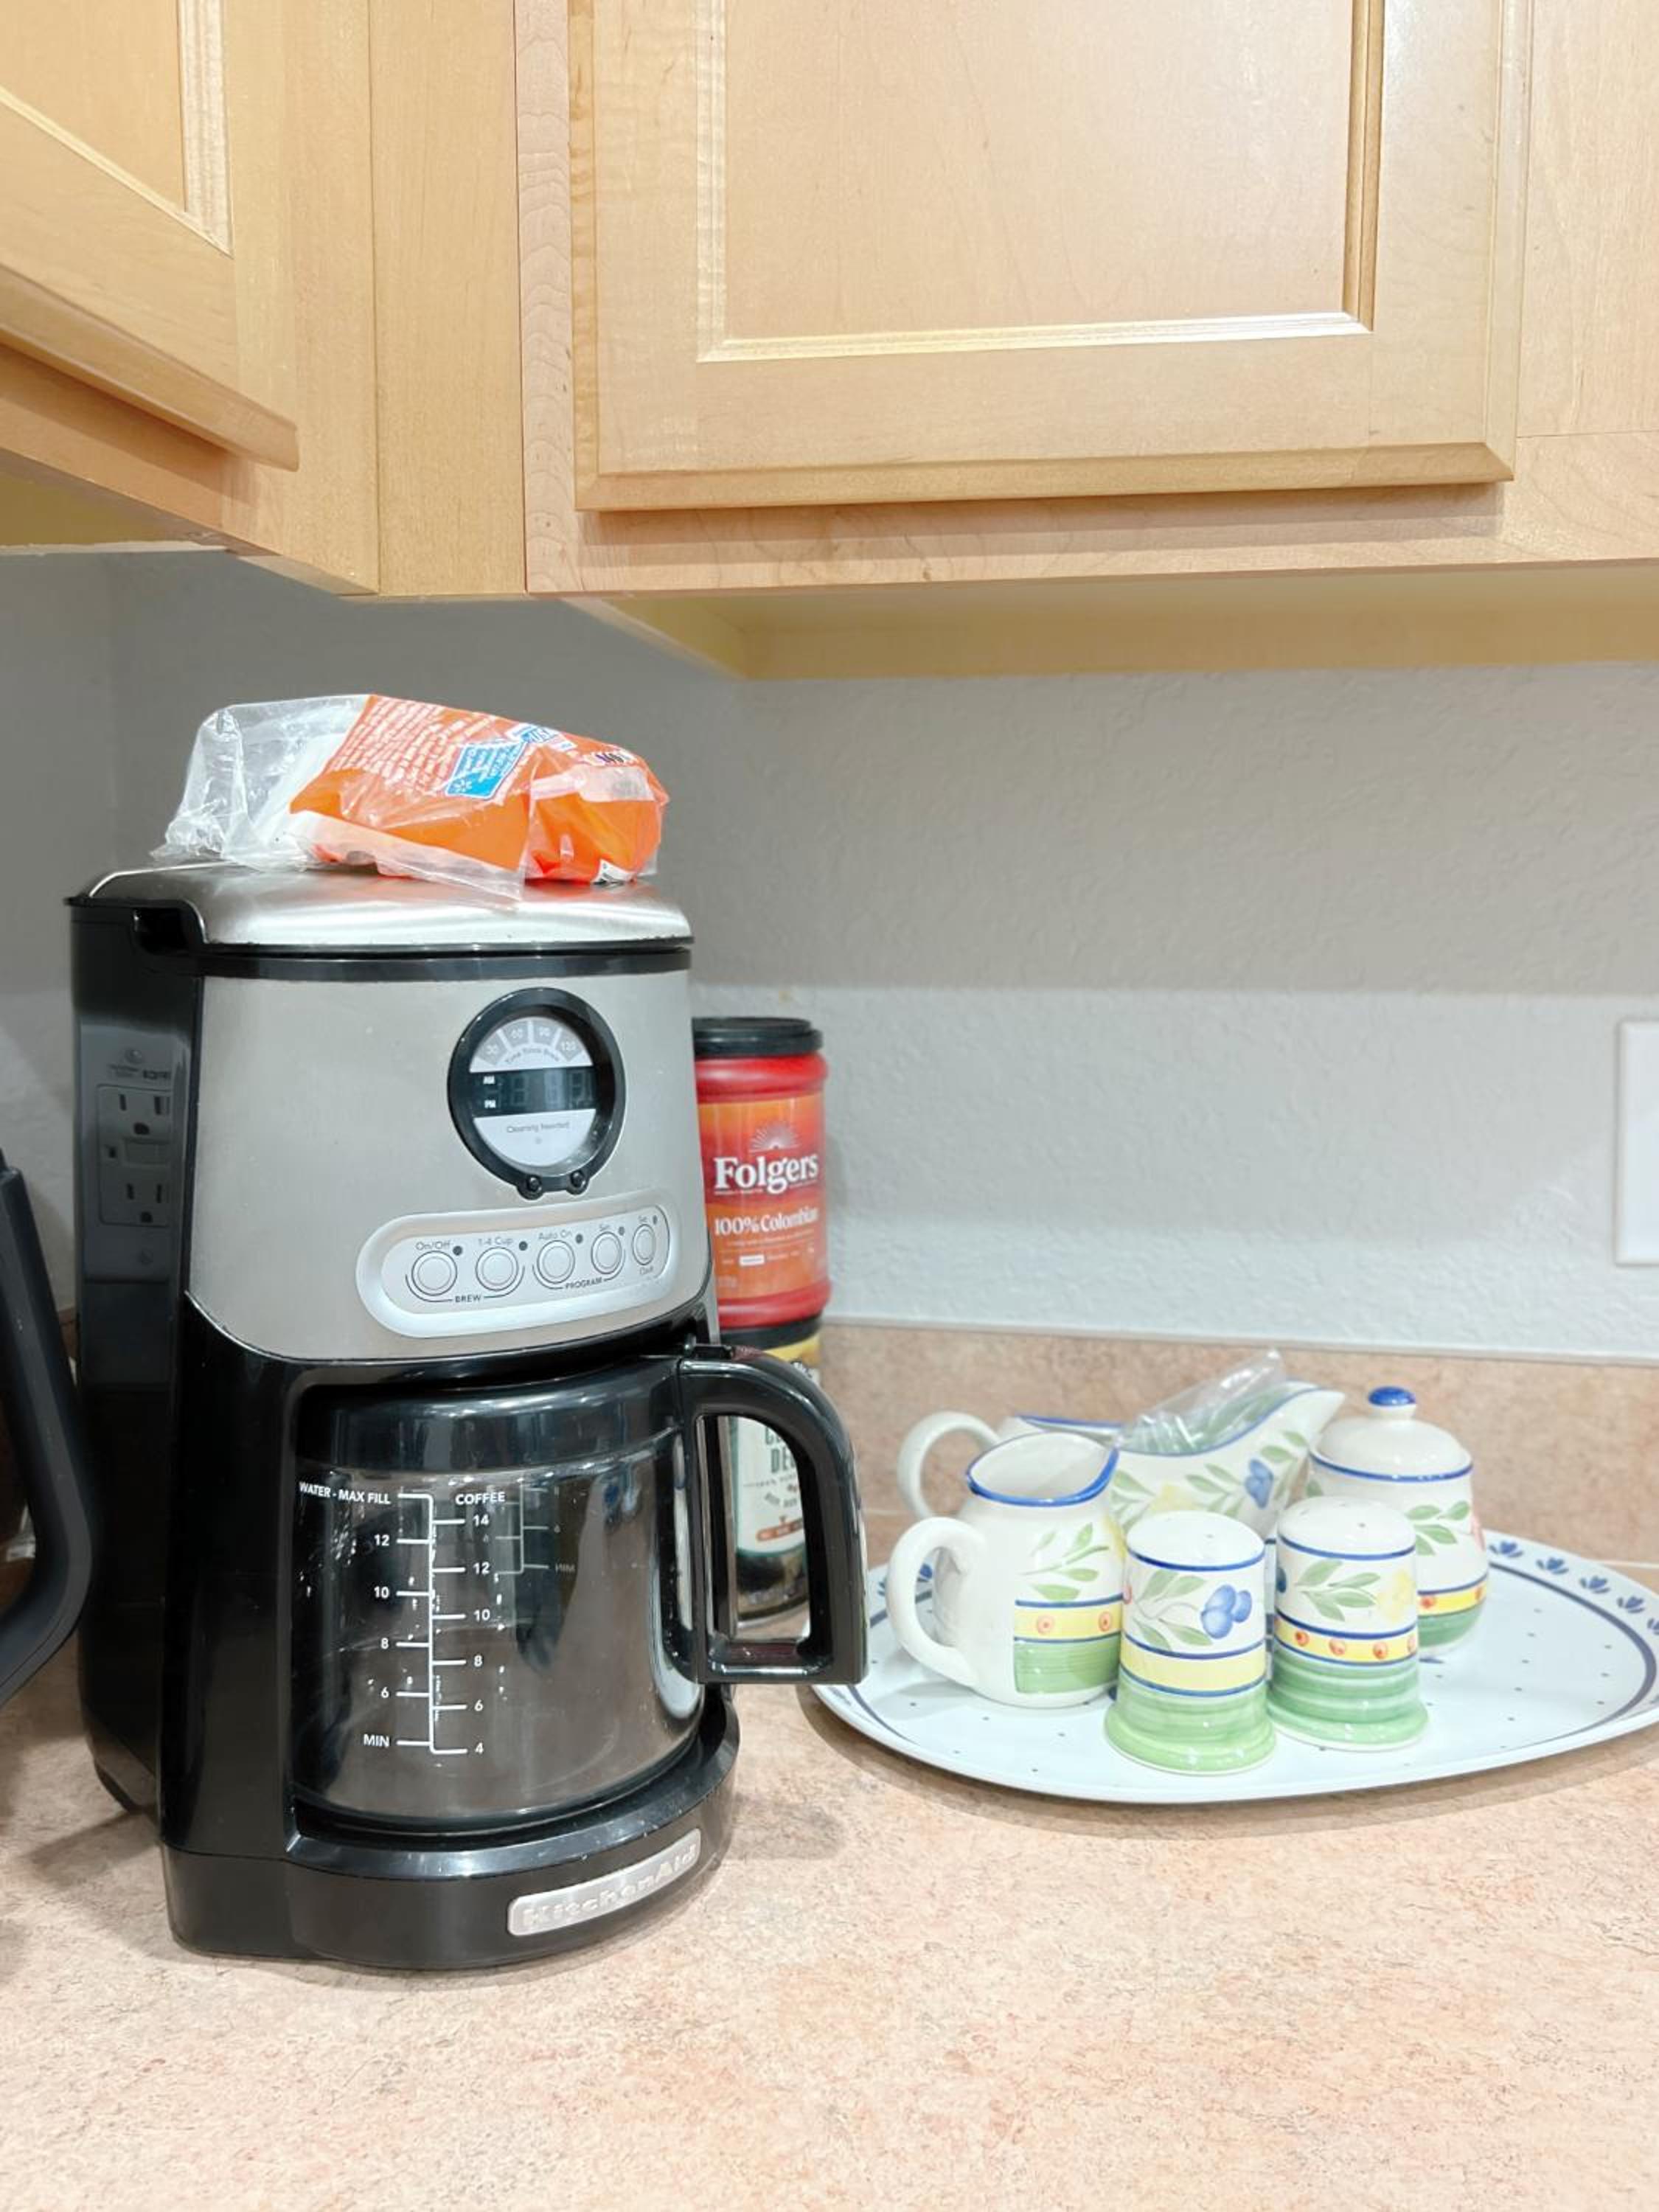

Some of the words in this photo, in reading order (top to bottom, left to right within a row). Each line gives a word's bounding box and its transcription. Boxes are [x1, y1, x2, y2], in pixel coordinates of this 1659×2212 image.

[713, 1154, 819, 1194] Folgers
[714, 1216, 759, 1236] 100%
[565, 1277, 603, 1289] PROGRAM
[454, 1294, 481, 1303] BREW
[299, 1481, 331, 1498] WATER
[338, 1489, 365, 1503] MAX
[368, 1491, 392, 1505] FILL
[455, 1491, 506, 1506] COFFEE
[473, 1514, 490, 1527] 14
[374, 1534, 390, 1547] 12
[473, 1561, 490, 1575] 12
[374, 1586, 390, 1599] 10
[473, 1608, 491, 1621] 10
[380, 1637, 390, 1650] 8
[473, 1654, 484, 1668] 8
[380, 1686, 390, 1699] 6
[474, 1700, 484, 1712] 6
[364, 1733, 391, 1747] MIN
[475, 1742, 484, 1754] 4
